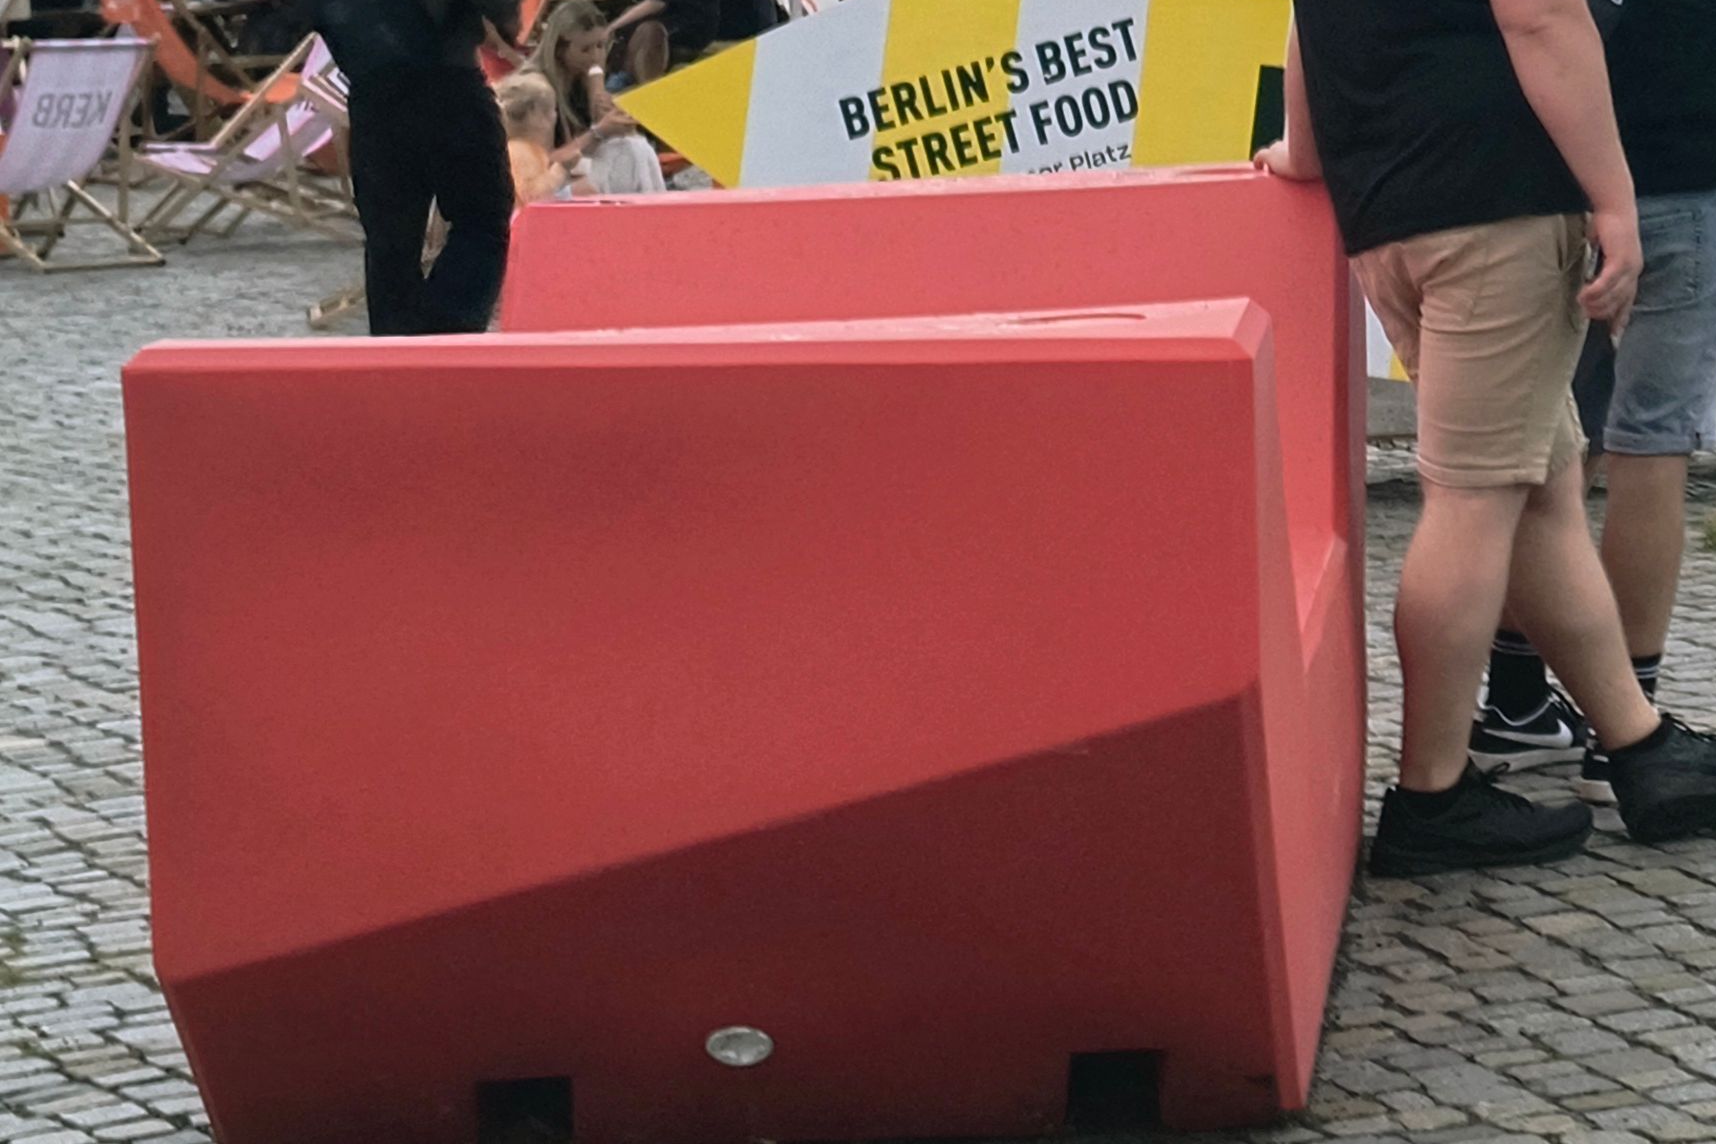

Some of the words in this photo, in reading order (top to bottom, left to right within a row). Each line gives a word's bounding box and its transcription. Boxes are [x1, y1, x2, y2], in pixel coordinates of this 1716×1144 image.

[1036, 18, 1138, 85] BEST
[872, 110, 1020, 182] STREET
[1030, 79, 1140, 147] FOOD
[1069, 144, 1132, 172] Platz
